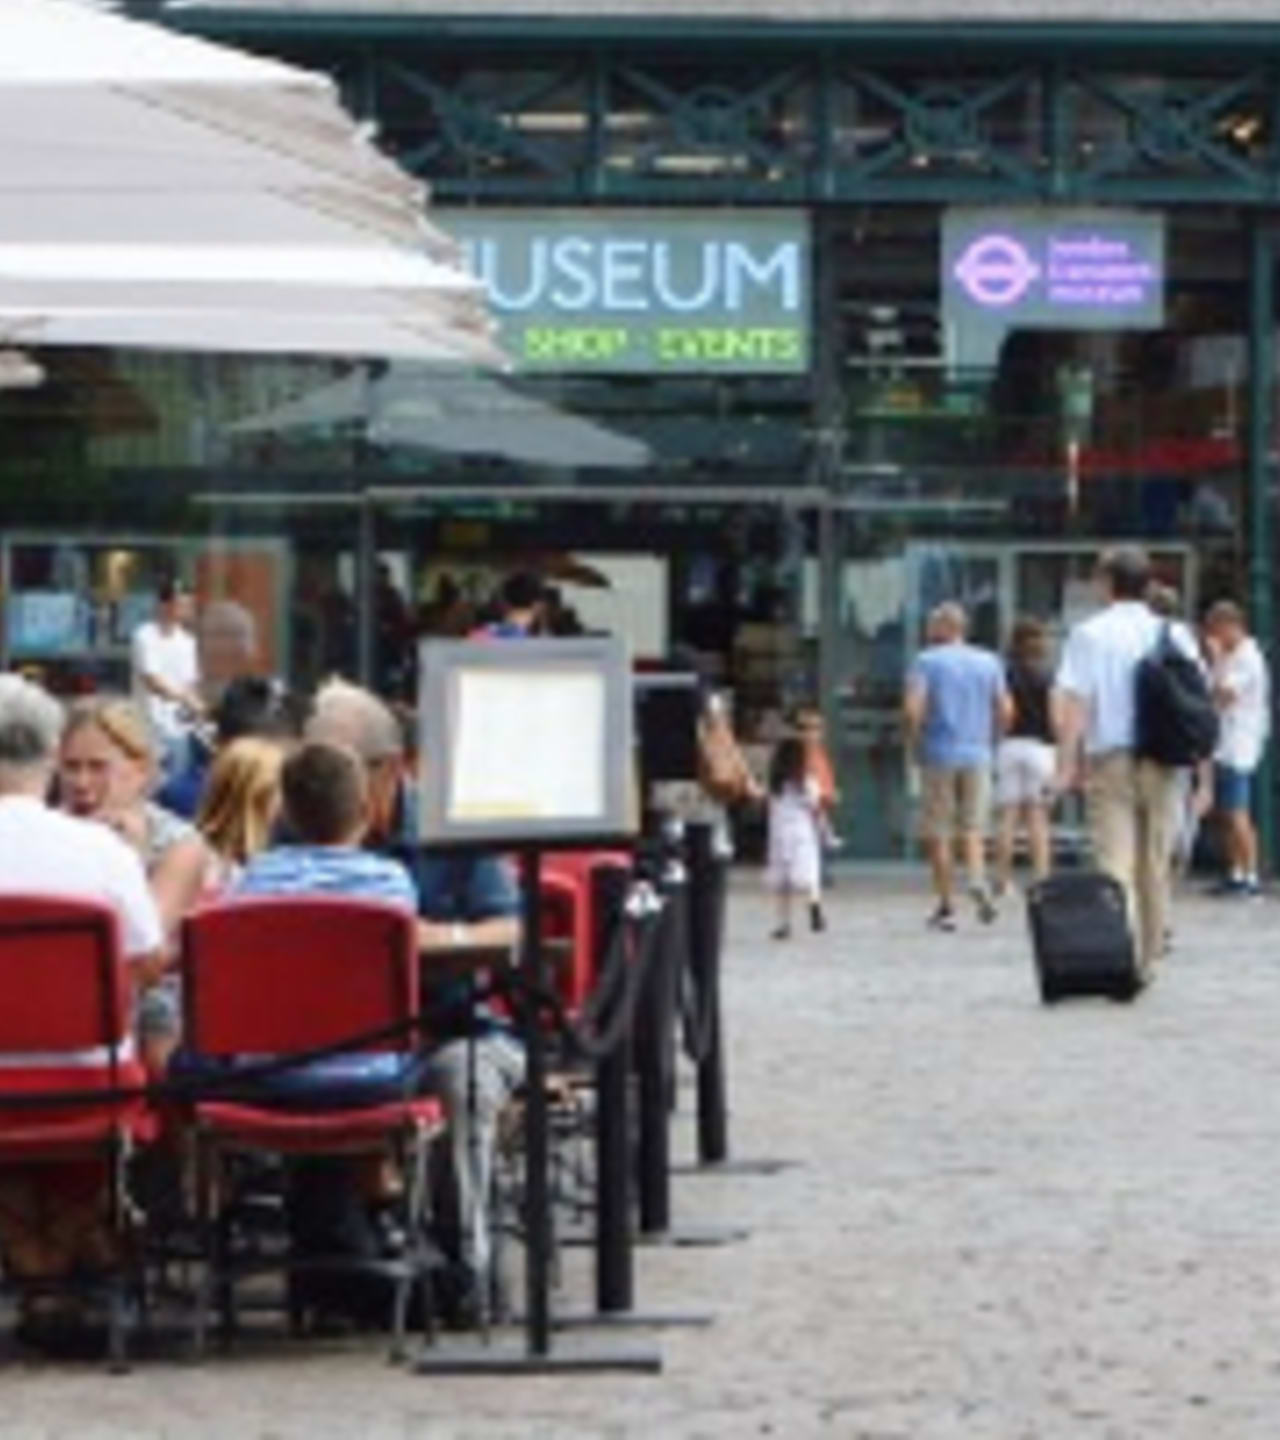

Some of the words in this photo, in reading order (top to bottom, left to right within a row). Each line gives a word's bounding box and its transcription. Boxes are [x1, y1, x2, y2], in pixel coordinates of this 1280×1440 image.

[462, 235, 799, 310] USEUM
[524, 327, 628, 359] SHOP
[658, 327, 800, 359] EVENTS
